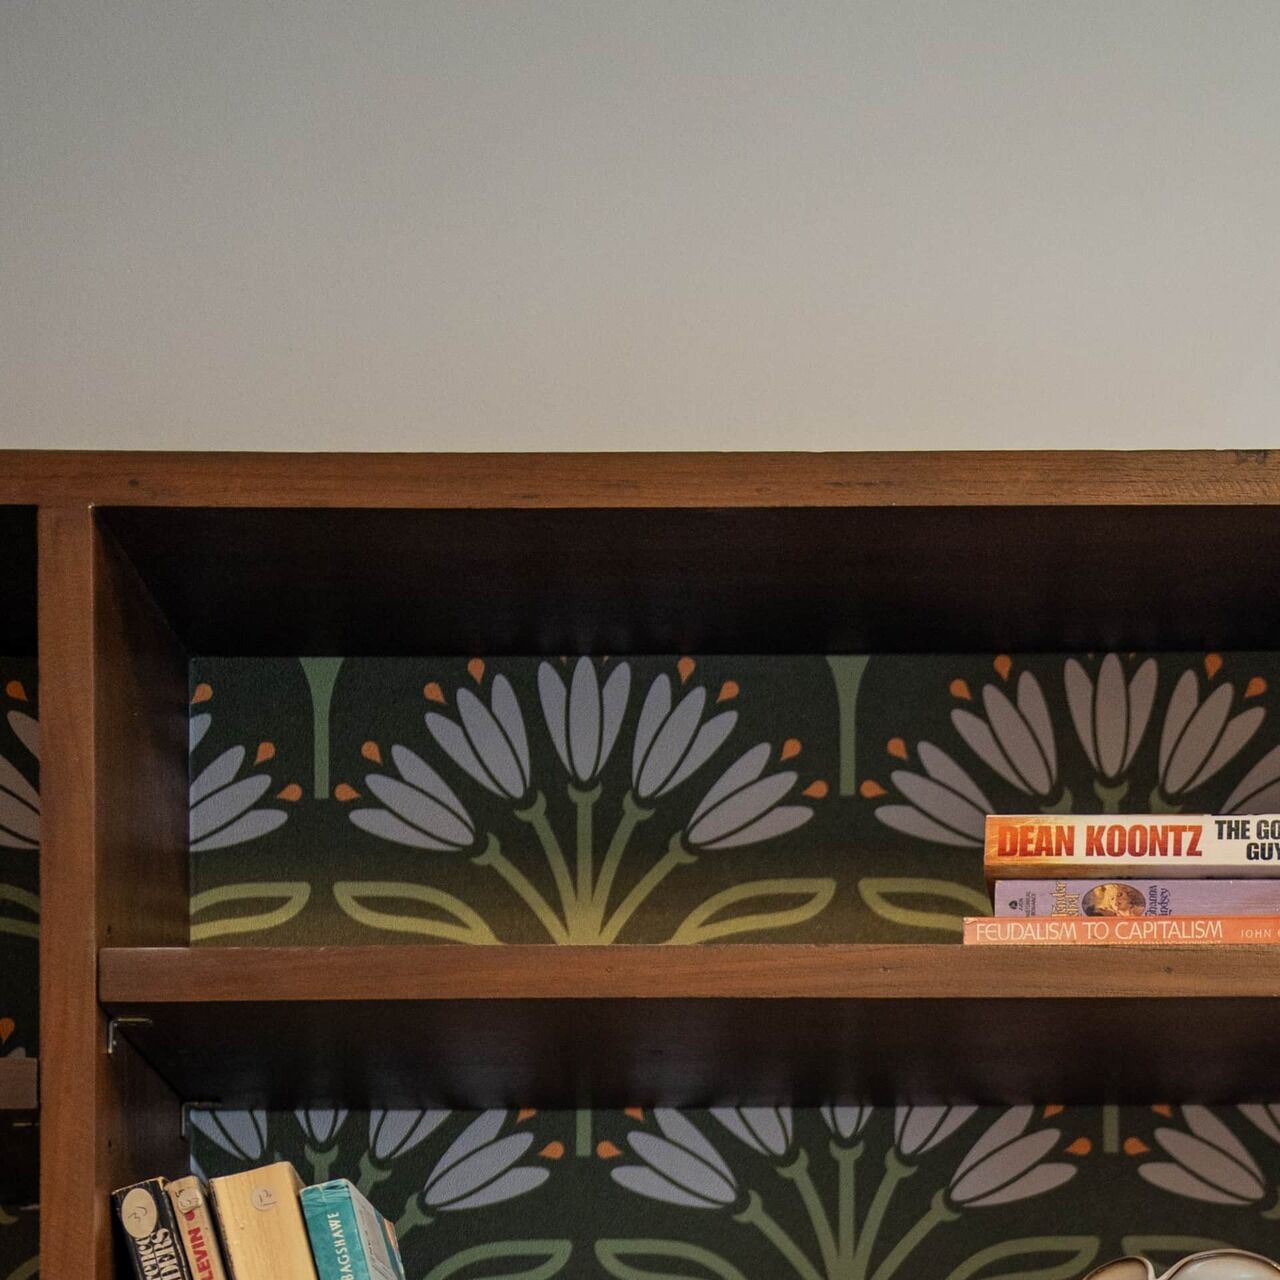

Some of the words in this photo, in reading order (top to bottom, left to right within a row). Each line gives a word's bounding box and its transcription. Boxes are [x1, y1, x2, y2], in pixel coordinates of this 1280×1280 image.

[1215, 820, 1250, 840] THE
[997, 825, 1075, 857] DEAN
[1085, 824, 1203, 858] KOONTZ
[976, 921, 1077, 941] FEUDALISM
[1082, 921, 1109, 940] TO
[1115, 920, 1223, 940] CAPITALISM
[1241, 928, 1272, 938] JOHN
